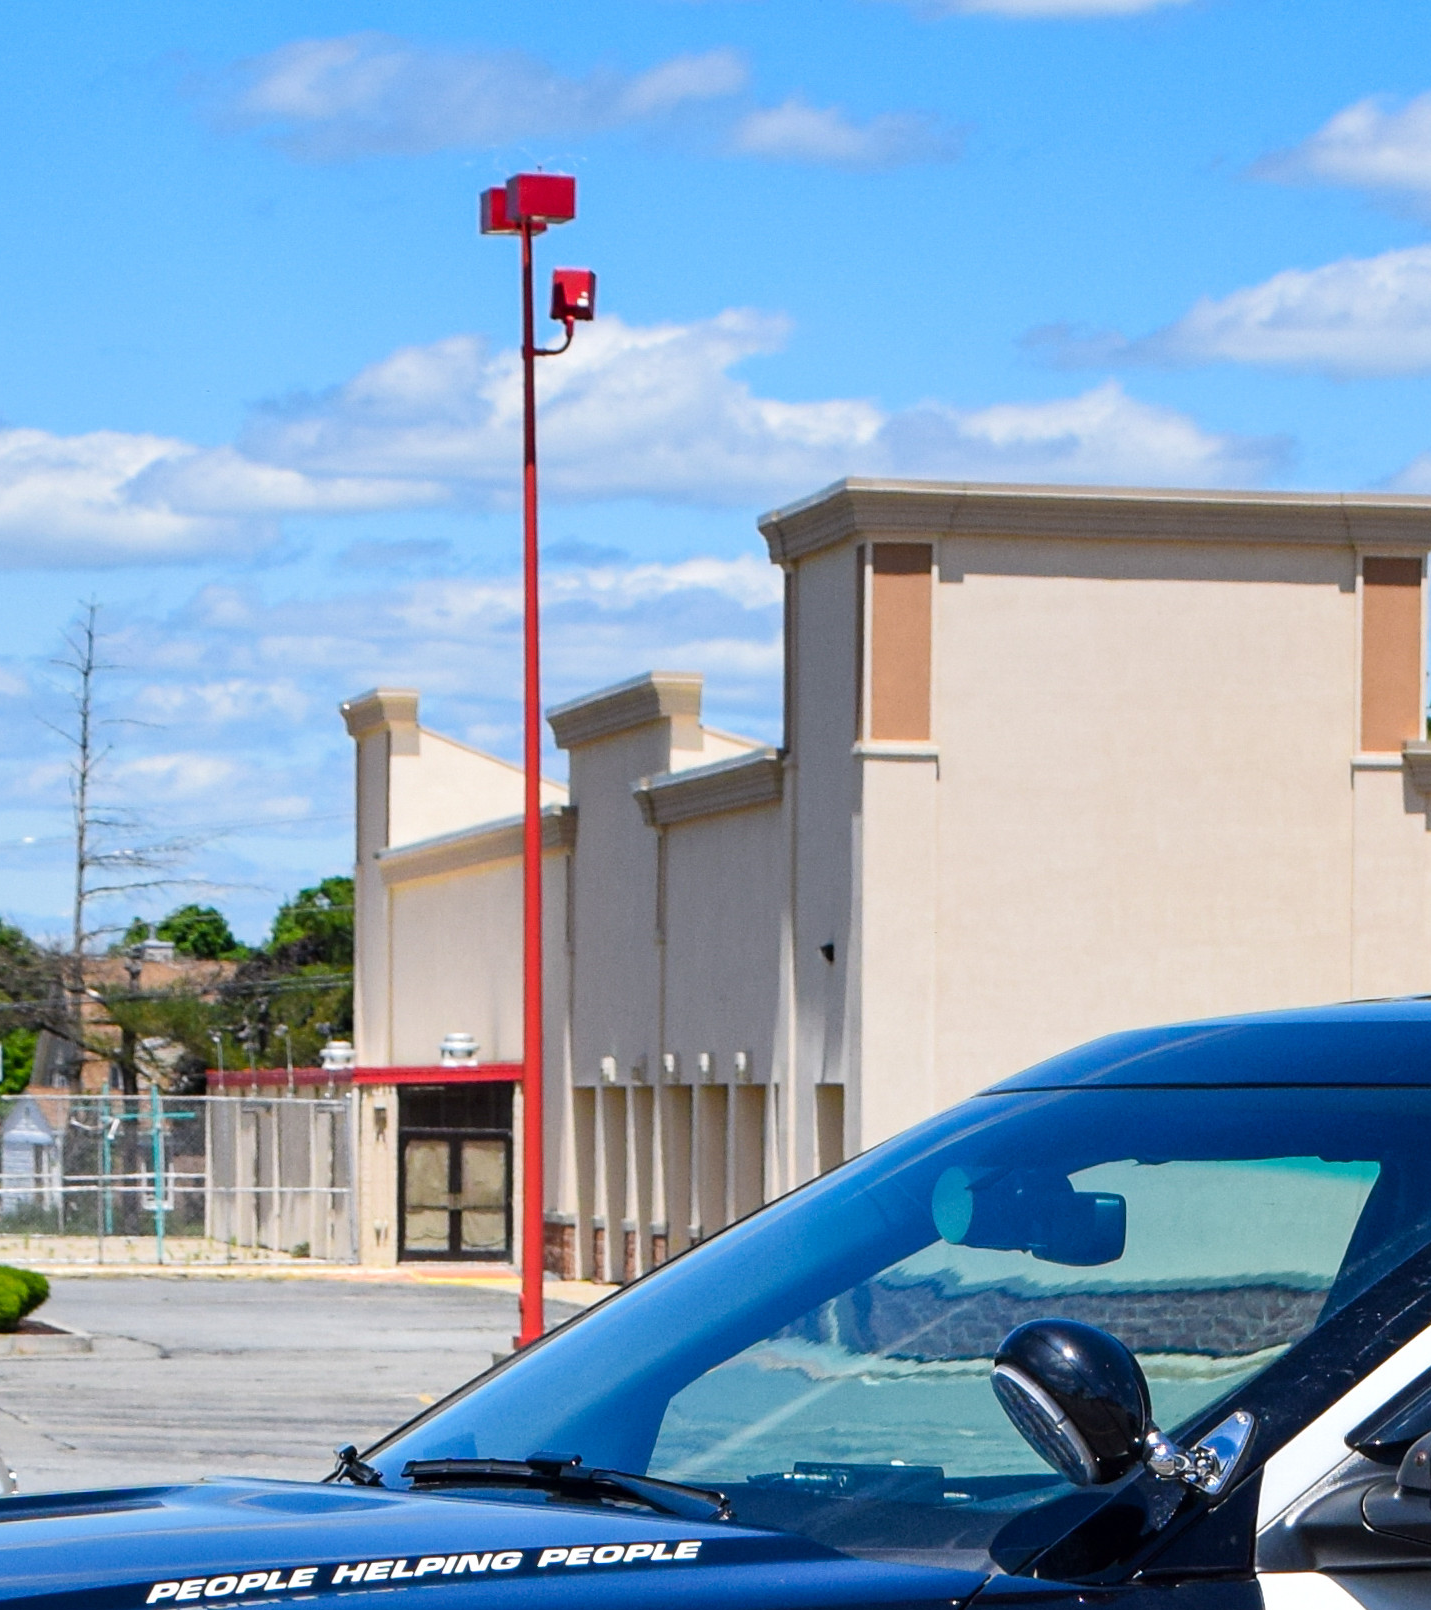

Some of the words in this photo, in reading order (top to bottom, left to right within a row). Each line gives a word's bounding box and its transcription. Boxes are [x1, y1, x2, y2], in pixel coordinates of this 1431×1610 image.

[146, 1567, 319, 1605] PEOPLE
[330, 1551, 524, 1585] HELPING
[536, 1541, 703, 1569] PEOPLE
